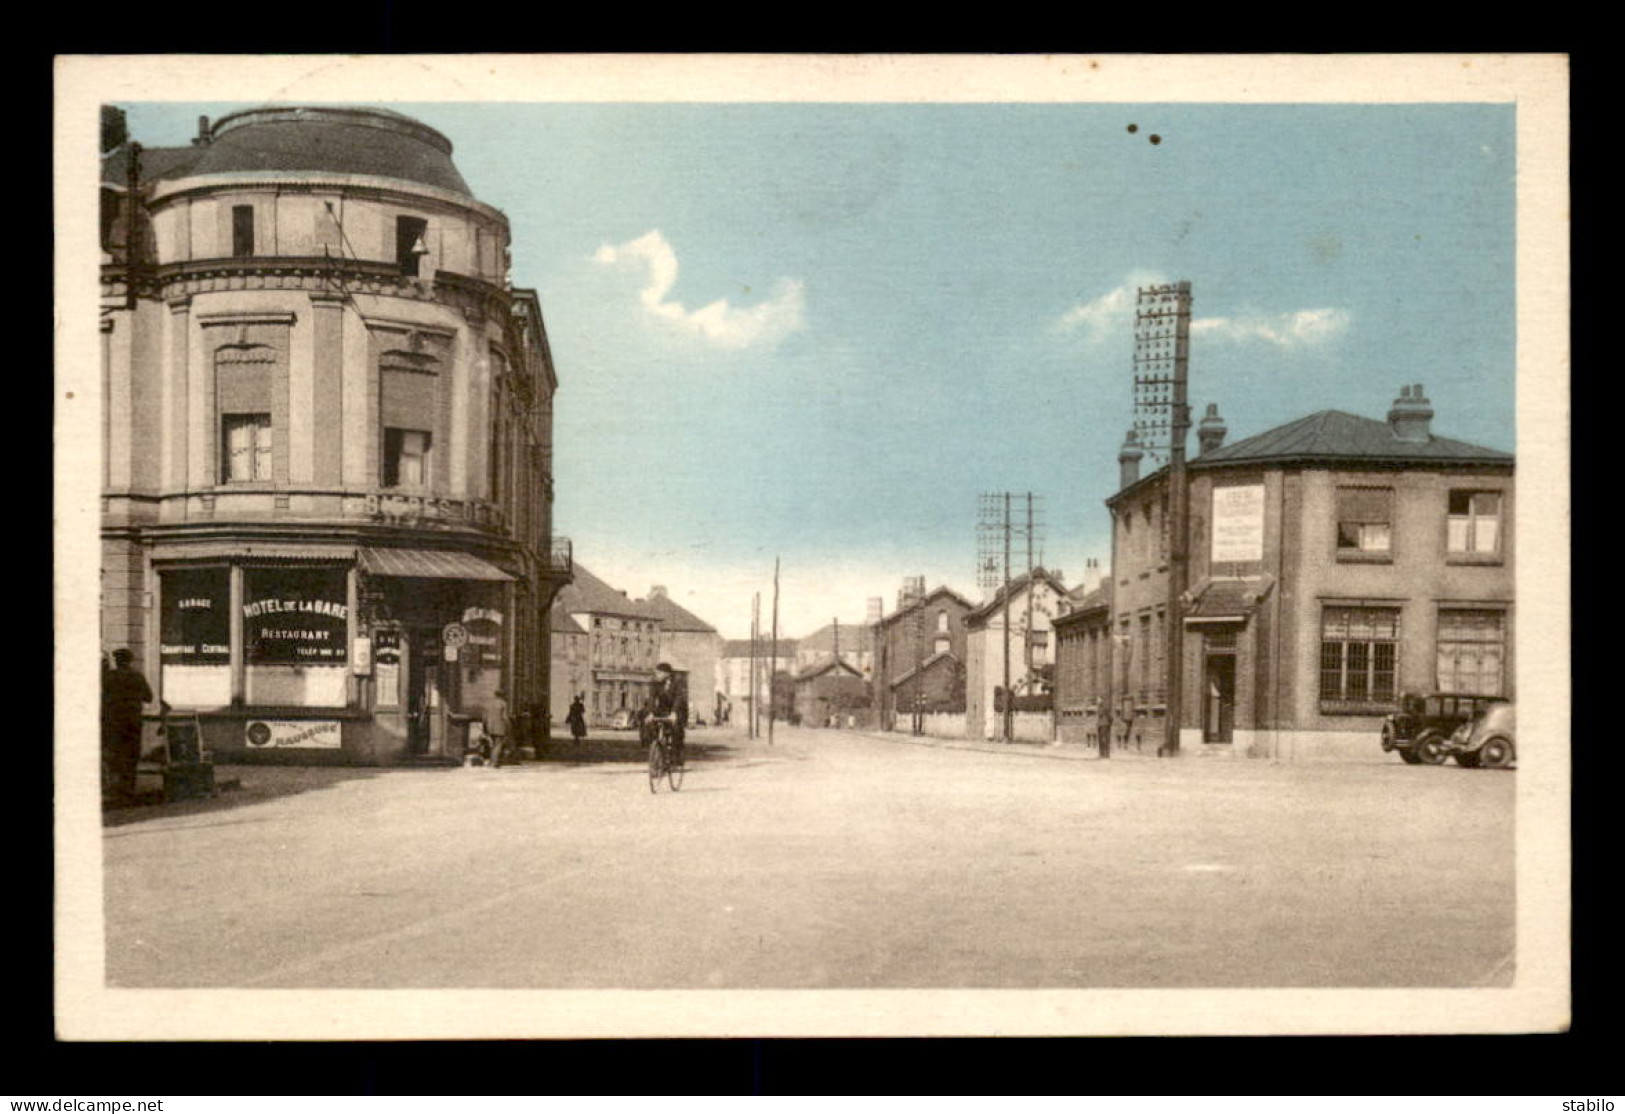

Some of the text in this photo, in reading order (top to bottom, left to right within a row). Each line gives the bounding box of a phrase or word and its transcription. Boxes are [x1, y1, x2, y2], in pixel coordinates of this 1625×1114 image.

[243, 598, 283, 618] HOTEL
[298, 600, 313, 612] LA
[314, 599, 347, 619] GARE
[261, 628, 330, 640] RESTAURANT
